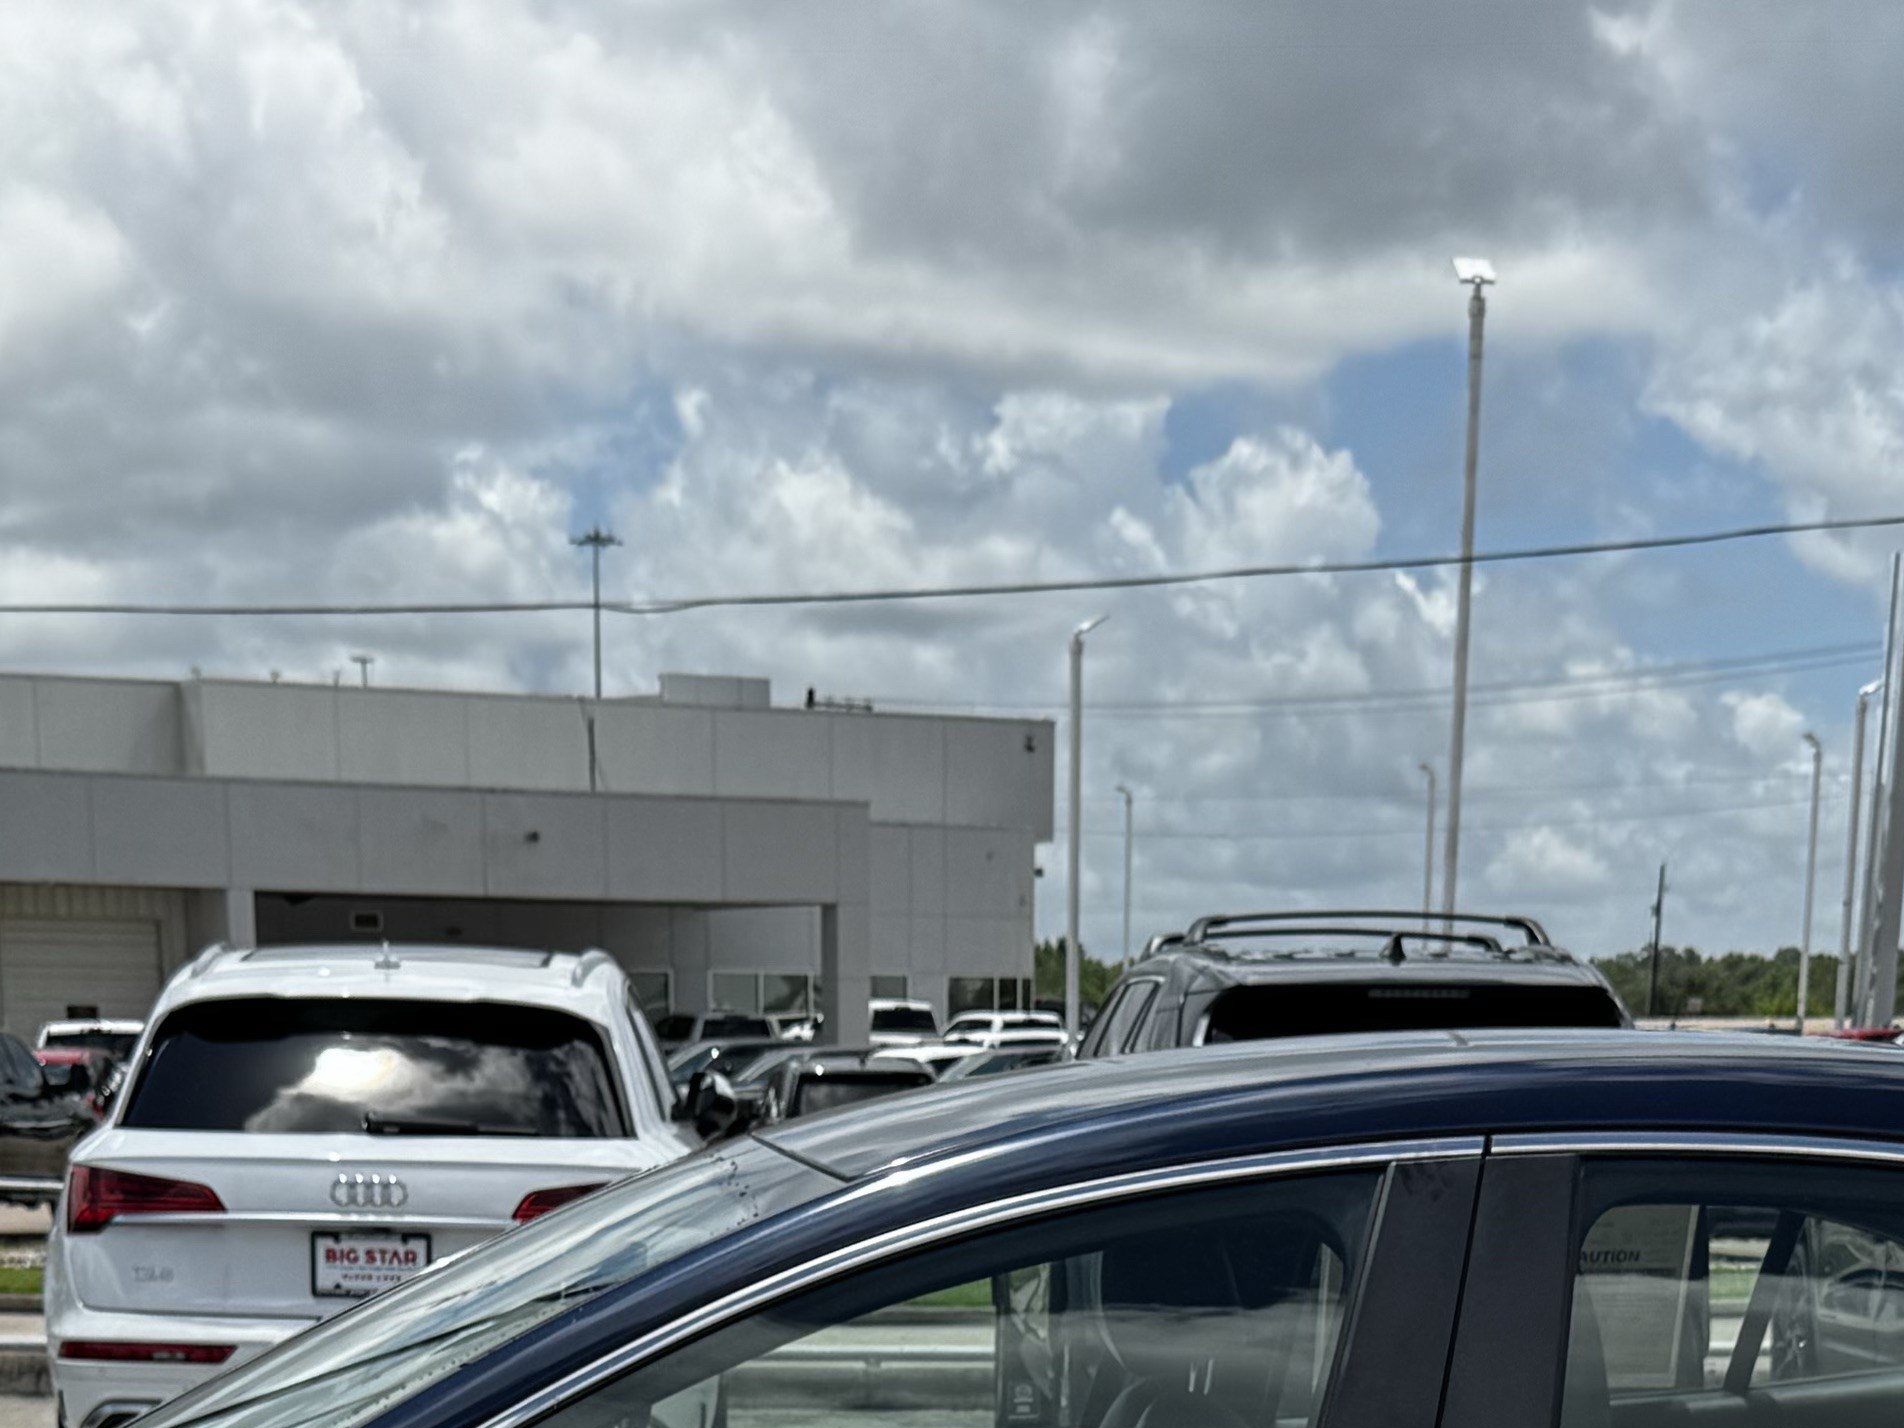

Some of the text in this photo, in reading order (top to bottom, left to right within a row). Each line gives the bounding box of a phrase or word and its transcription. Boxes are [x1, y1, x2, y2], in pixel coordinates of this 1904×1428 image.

[324, 1247, 418, 1266] BIG STAR
[1580, 1249, 1642, 1264] AUTION
